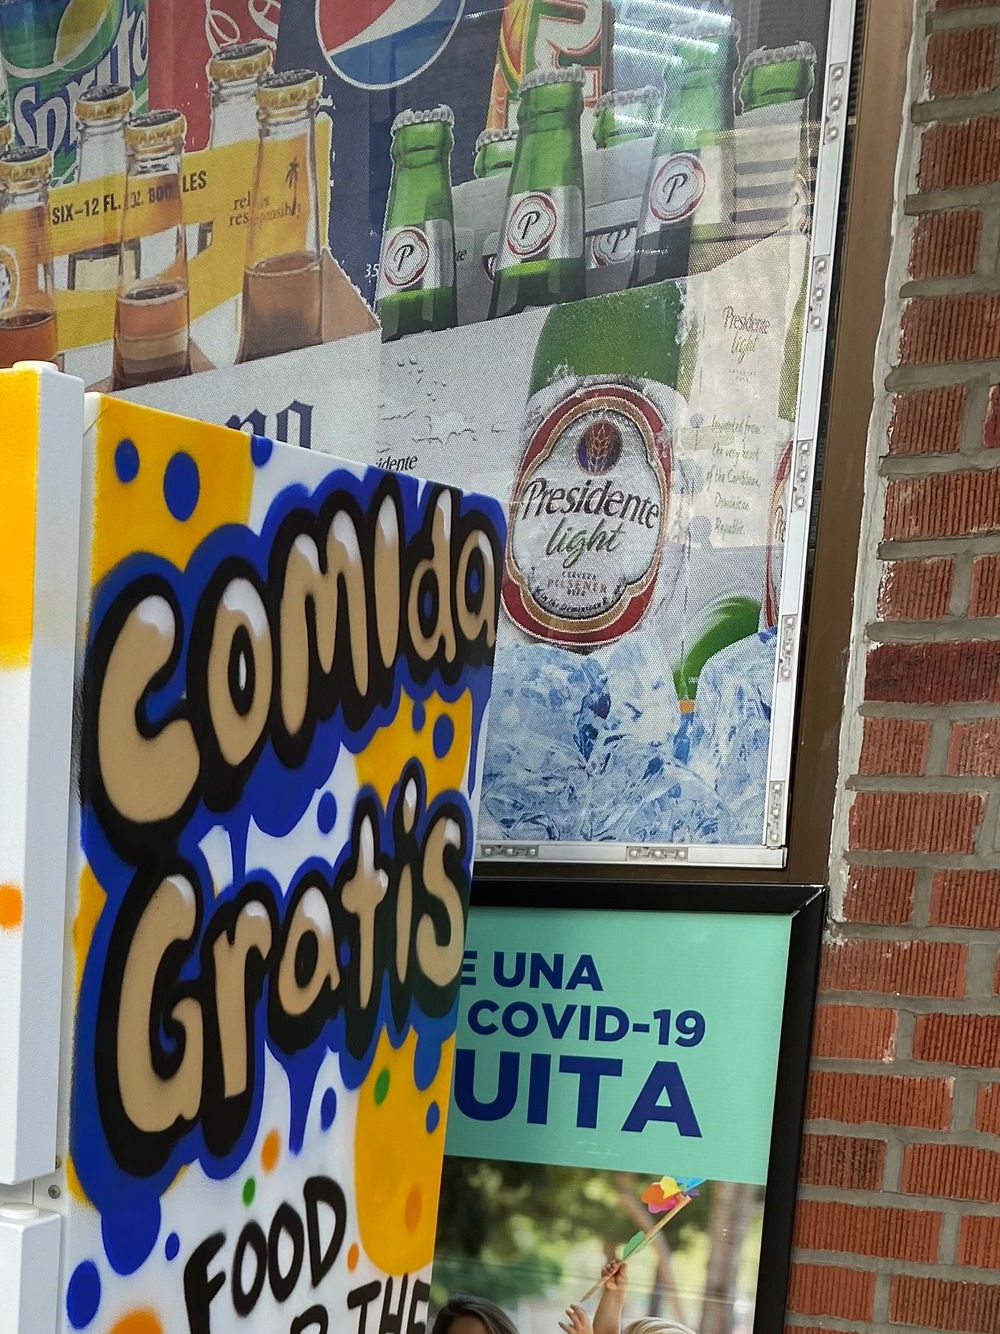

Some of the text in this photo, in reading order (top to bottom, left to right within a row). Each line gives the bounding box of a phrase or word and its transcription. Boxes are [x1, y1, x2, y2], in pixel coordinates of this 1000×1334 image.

[102, 193, 122, 214] FL.
[148, 170, 207, 204] BOTLES
[519, 210, 540, 239] P
[394, 244, 414, 271] P
[522, 476, 660, 530] Presidente
[545, 517, 626, 569] light
[547, 579, 607, 593] PILSENER
[493, 951, 604, 992] UNA
[467, 999, 707, 1047] COVID-19
[454, 1047, 703, 1139] UITA
